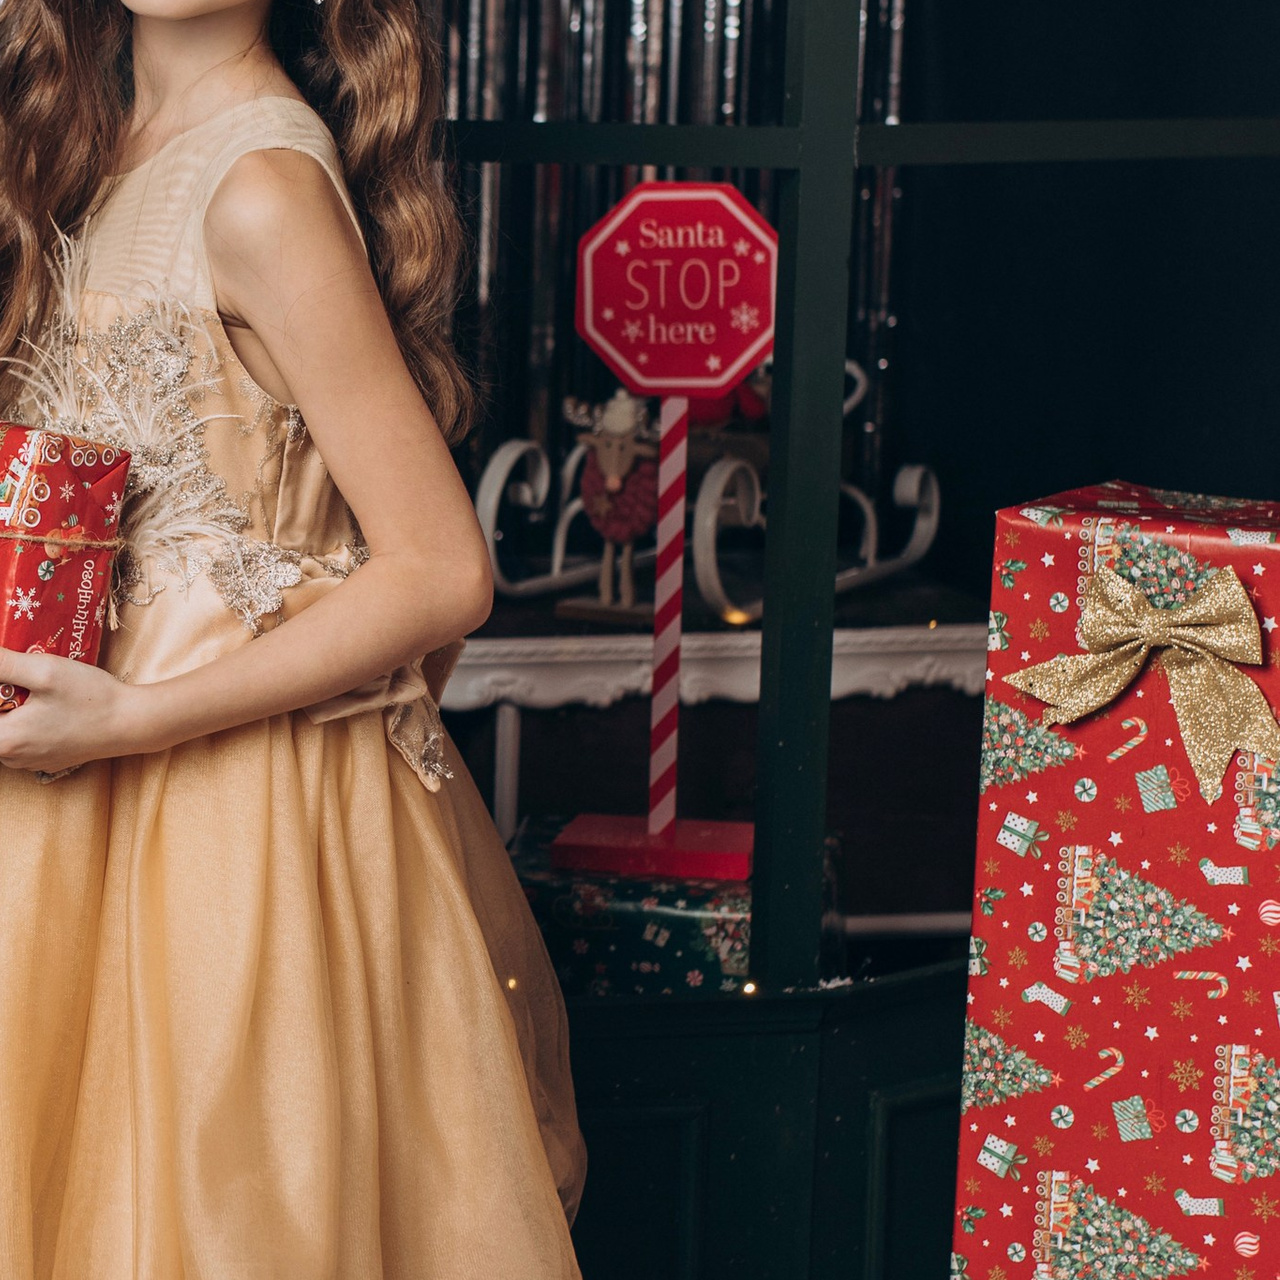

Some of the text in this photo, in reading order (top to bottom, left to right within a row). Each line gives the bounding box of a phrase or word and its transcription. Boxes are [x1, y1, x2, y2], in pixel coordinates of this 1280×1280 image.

[638, 218, 727, 249] Santa
[625, 258, 741, 311] STOP
[648, 313, 717, 345] here
[68, 559, 95, 660] аздничного
